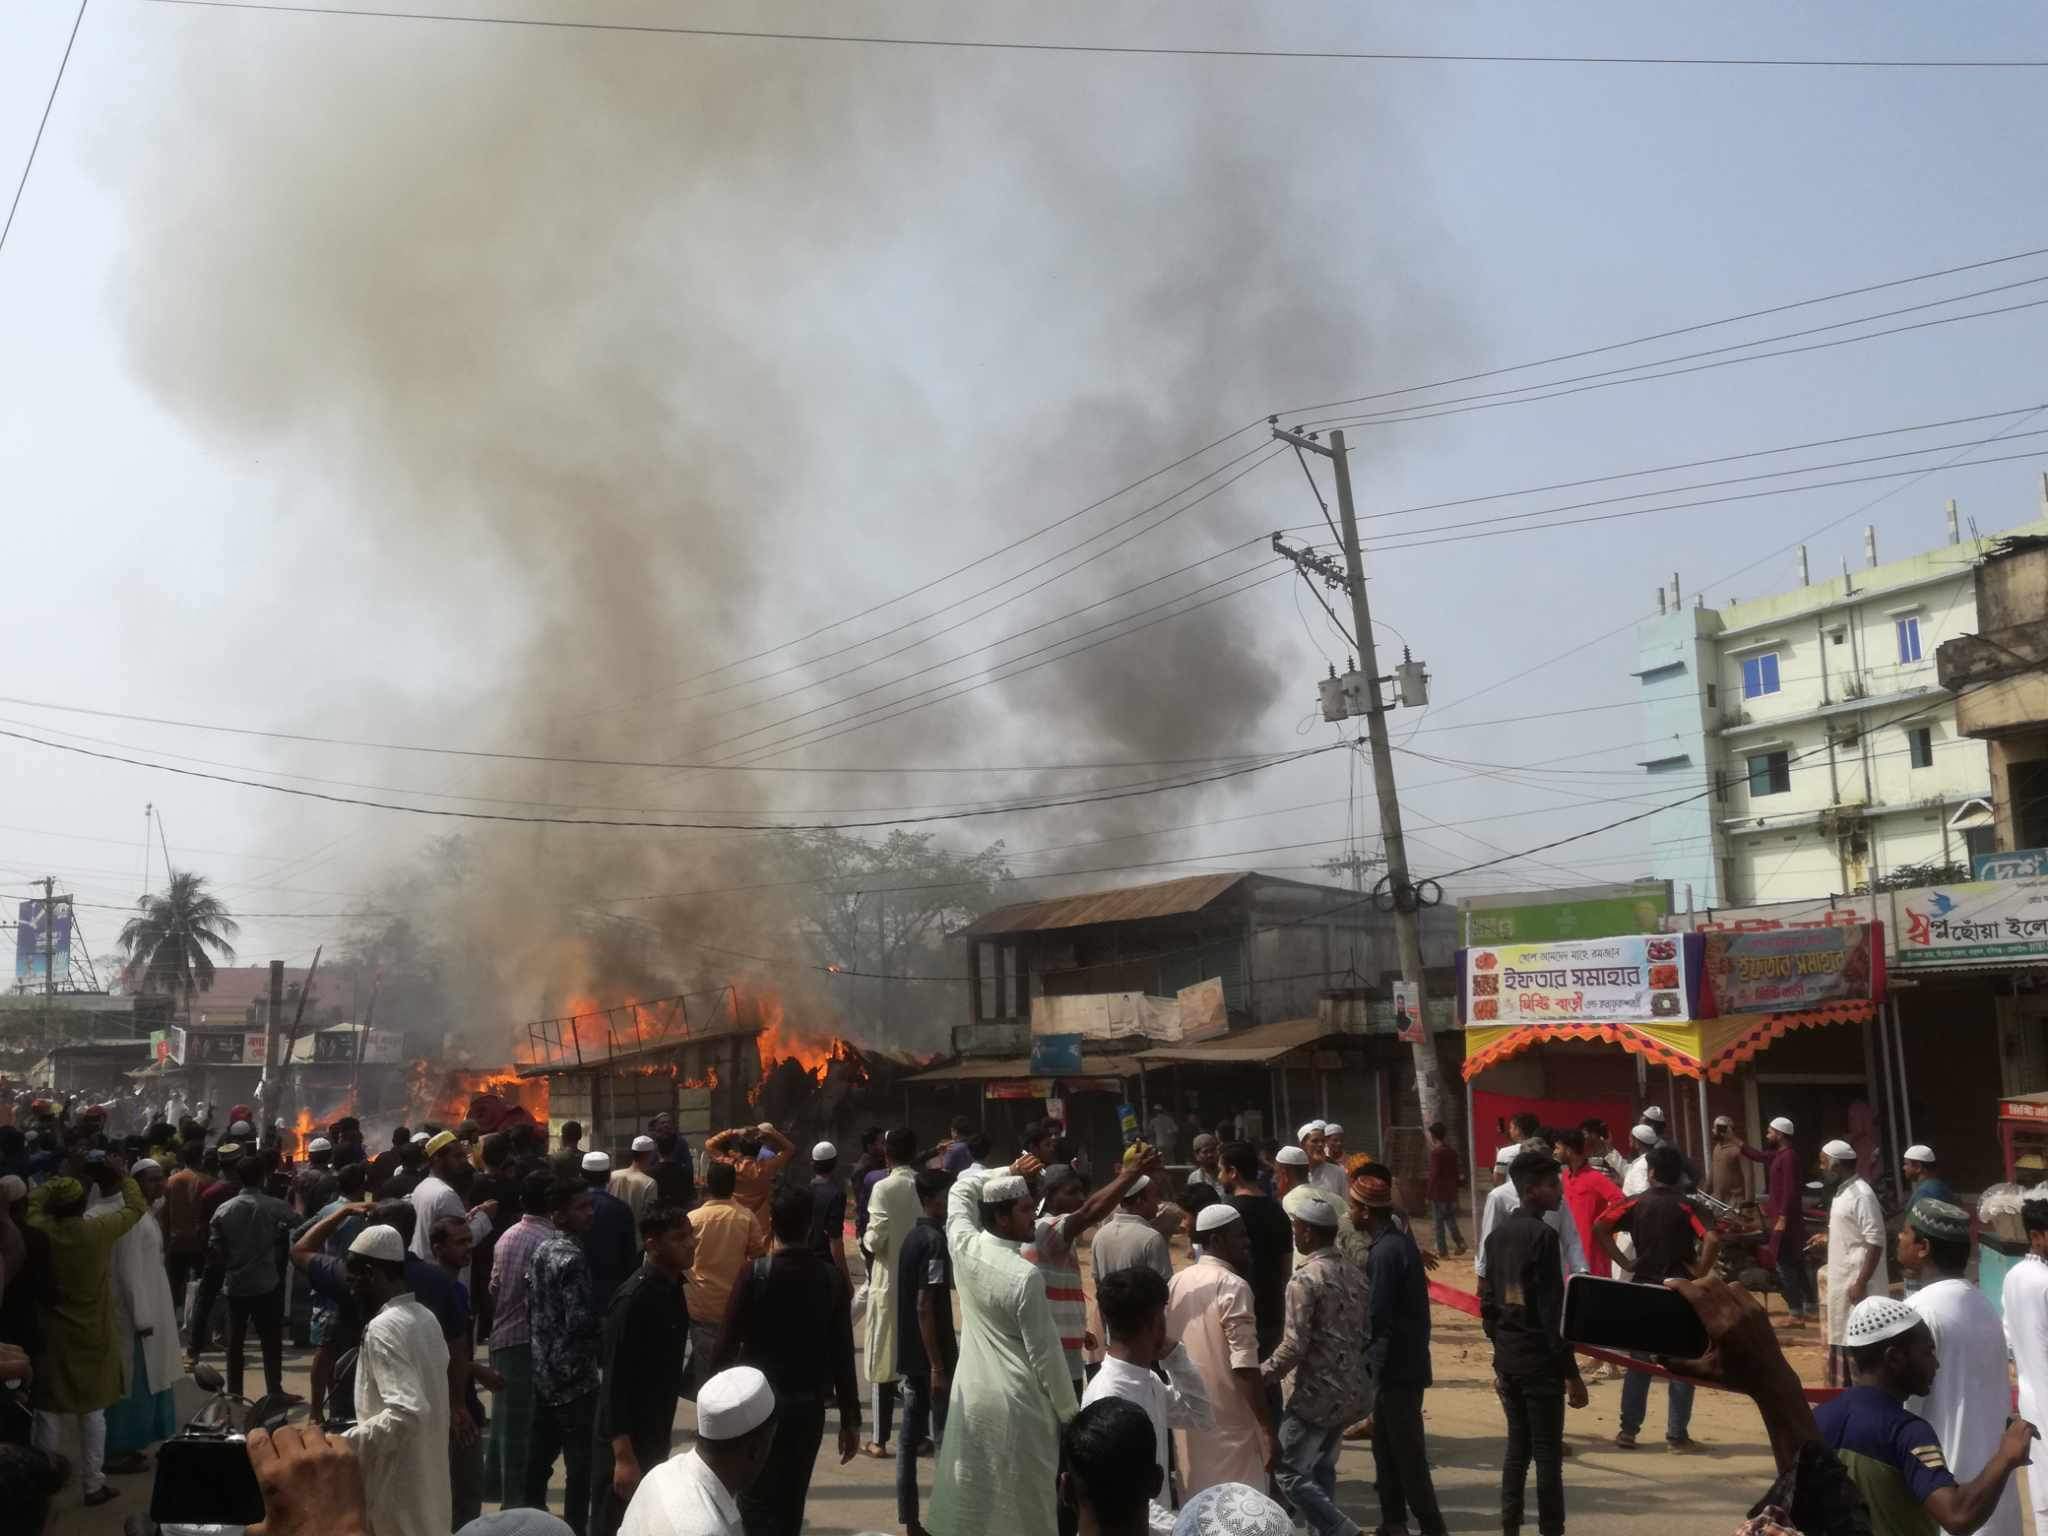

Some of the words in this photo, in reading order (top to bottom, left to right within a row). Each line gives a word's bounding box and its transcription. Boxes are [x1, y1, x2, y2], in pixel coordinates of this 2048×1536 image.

[1504, 967, 1567, 990] ইফতার
[1572, 966, 1641, 987] সমাহার
[1739, 953, 1792, 982] ইফতার
[1519, 992, 1550, 1012] মিষ্টি
